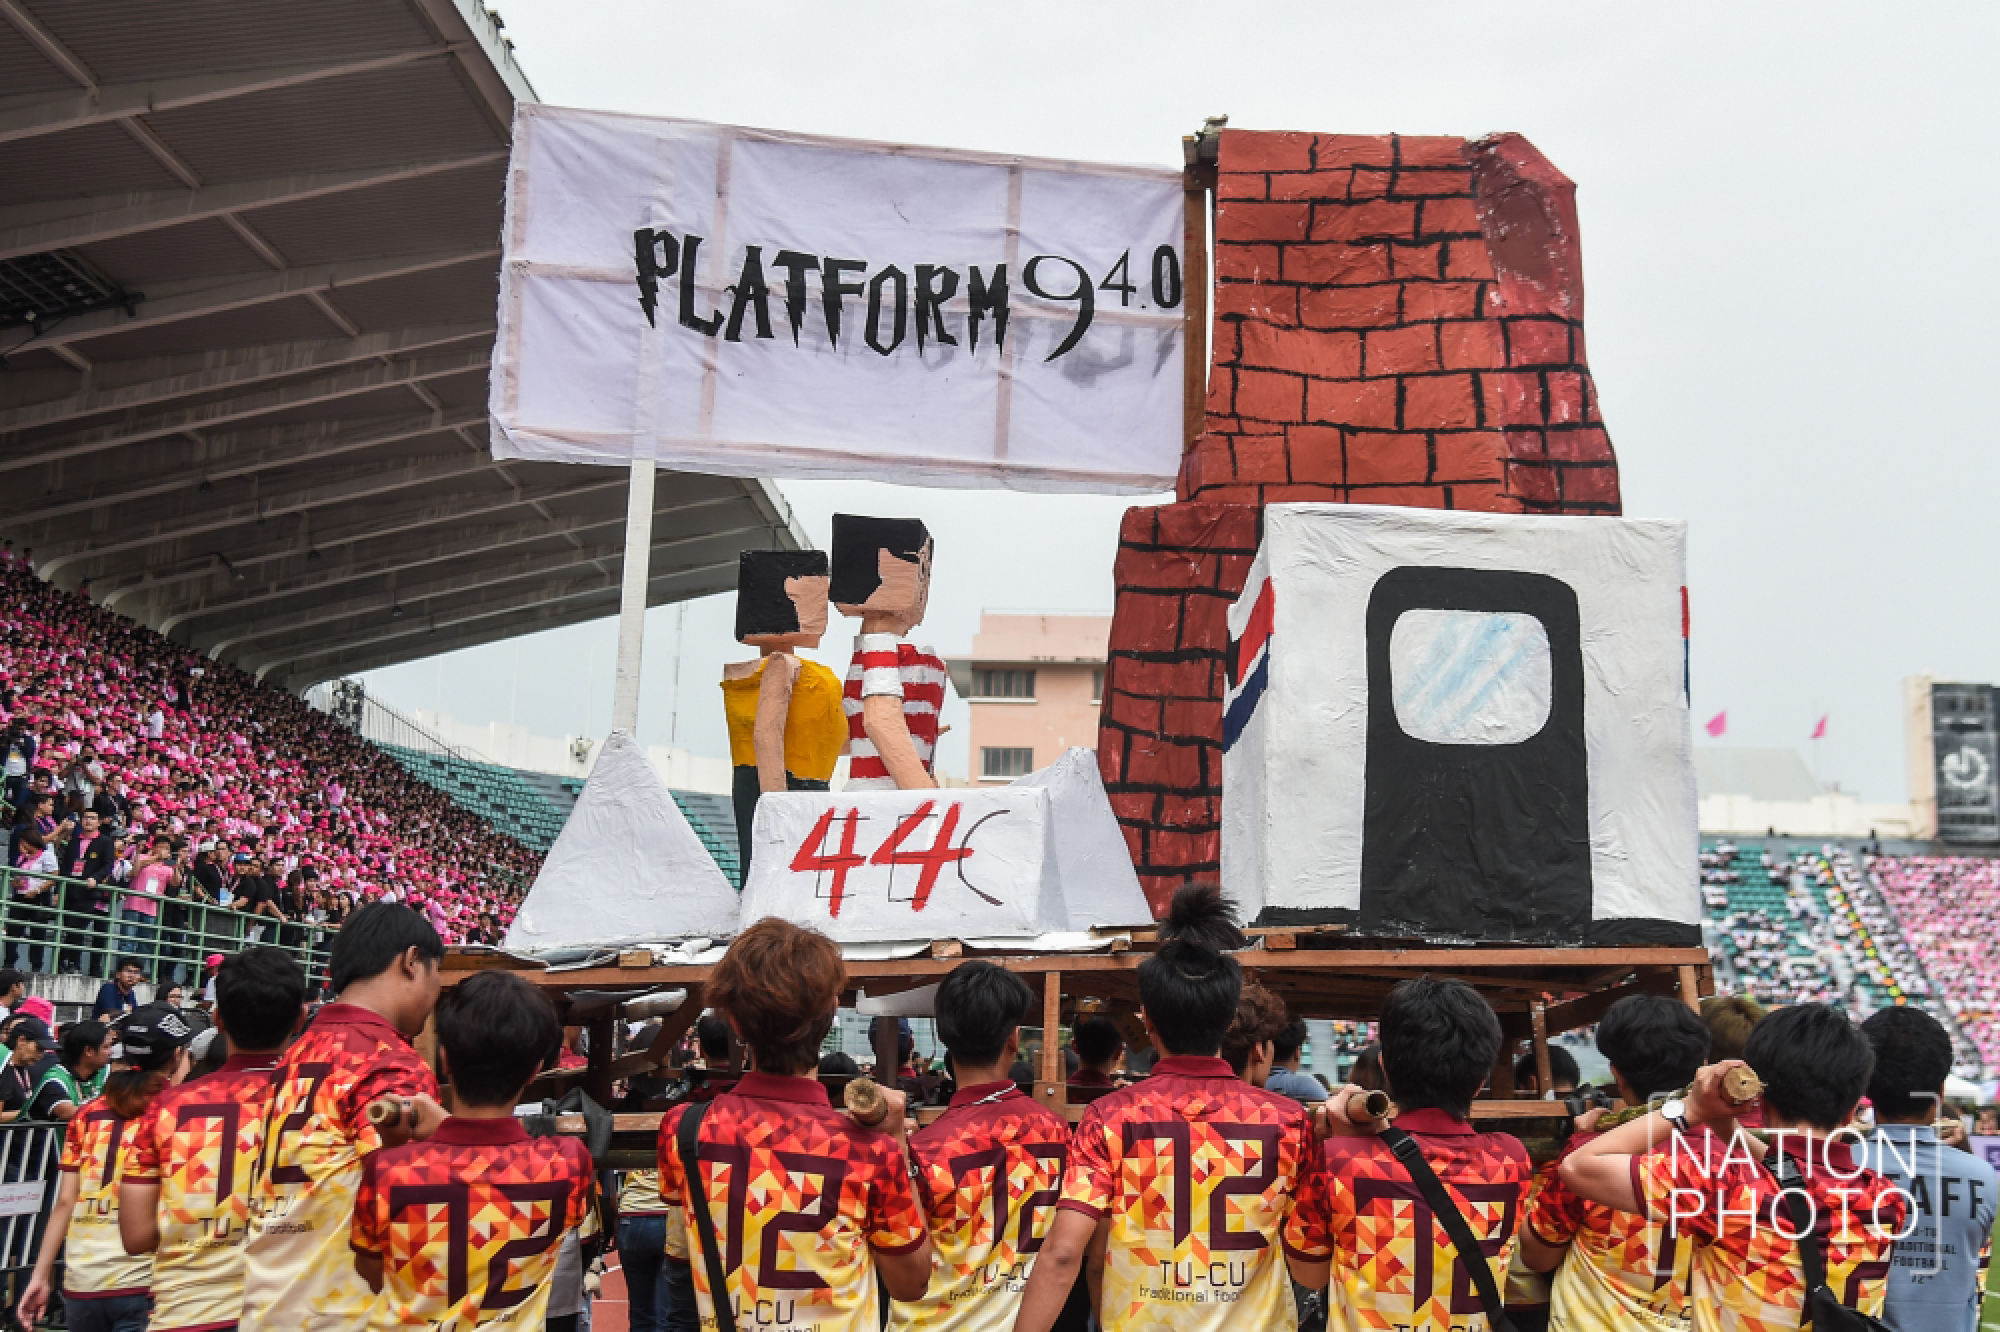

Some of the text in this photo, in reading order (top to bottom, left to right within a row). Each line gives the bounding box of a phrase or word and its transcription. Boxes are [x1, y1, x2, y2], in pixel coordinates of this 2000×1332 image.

[634, 228, 1010, 358] PLATFORM
[390, 1180, 569, 1310] 72
[694, 1142, 848, 1290] 72
[949, 1143, 1067, 1253] 72
[1122, 1121, 1280, 1251] 72
[1159, 1259, 1245, 1287] TU-CU
